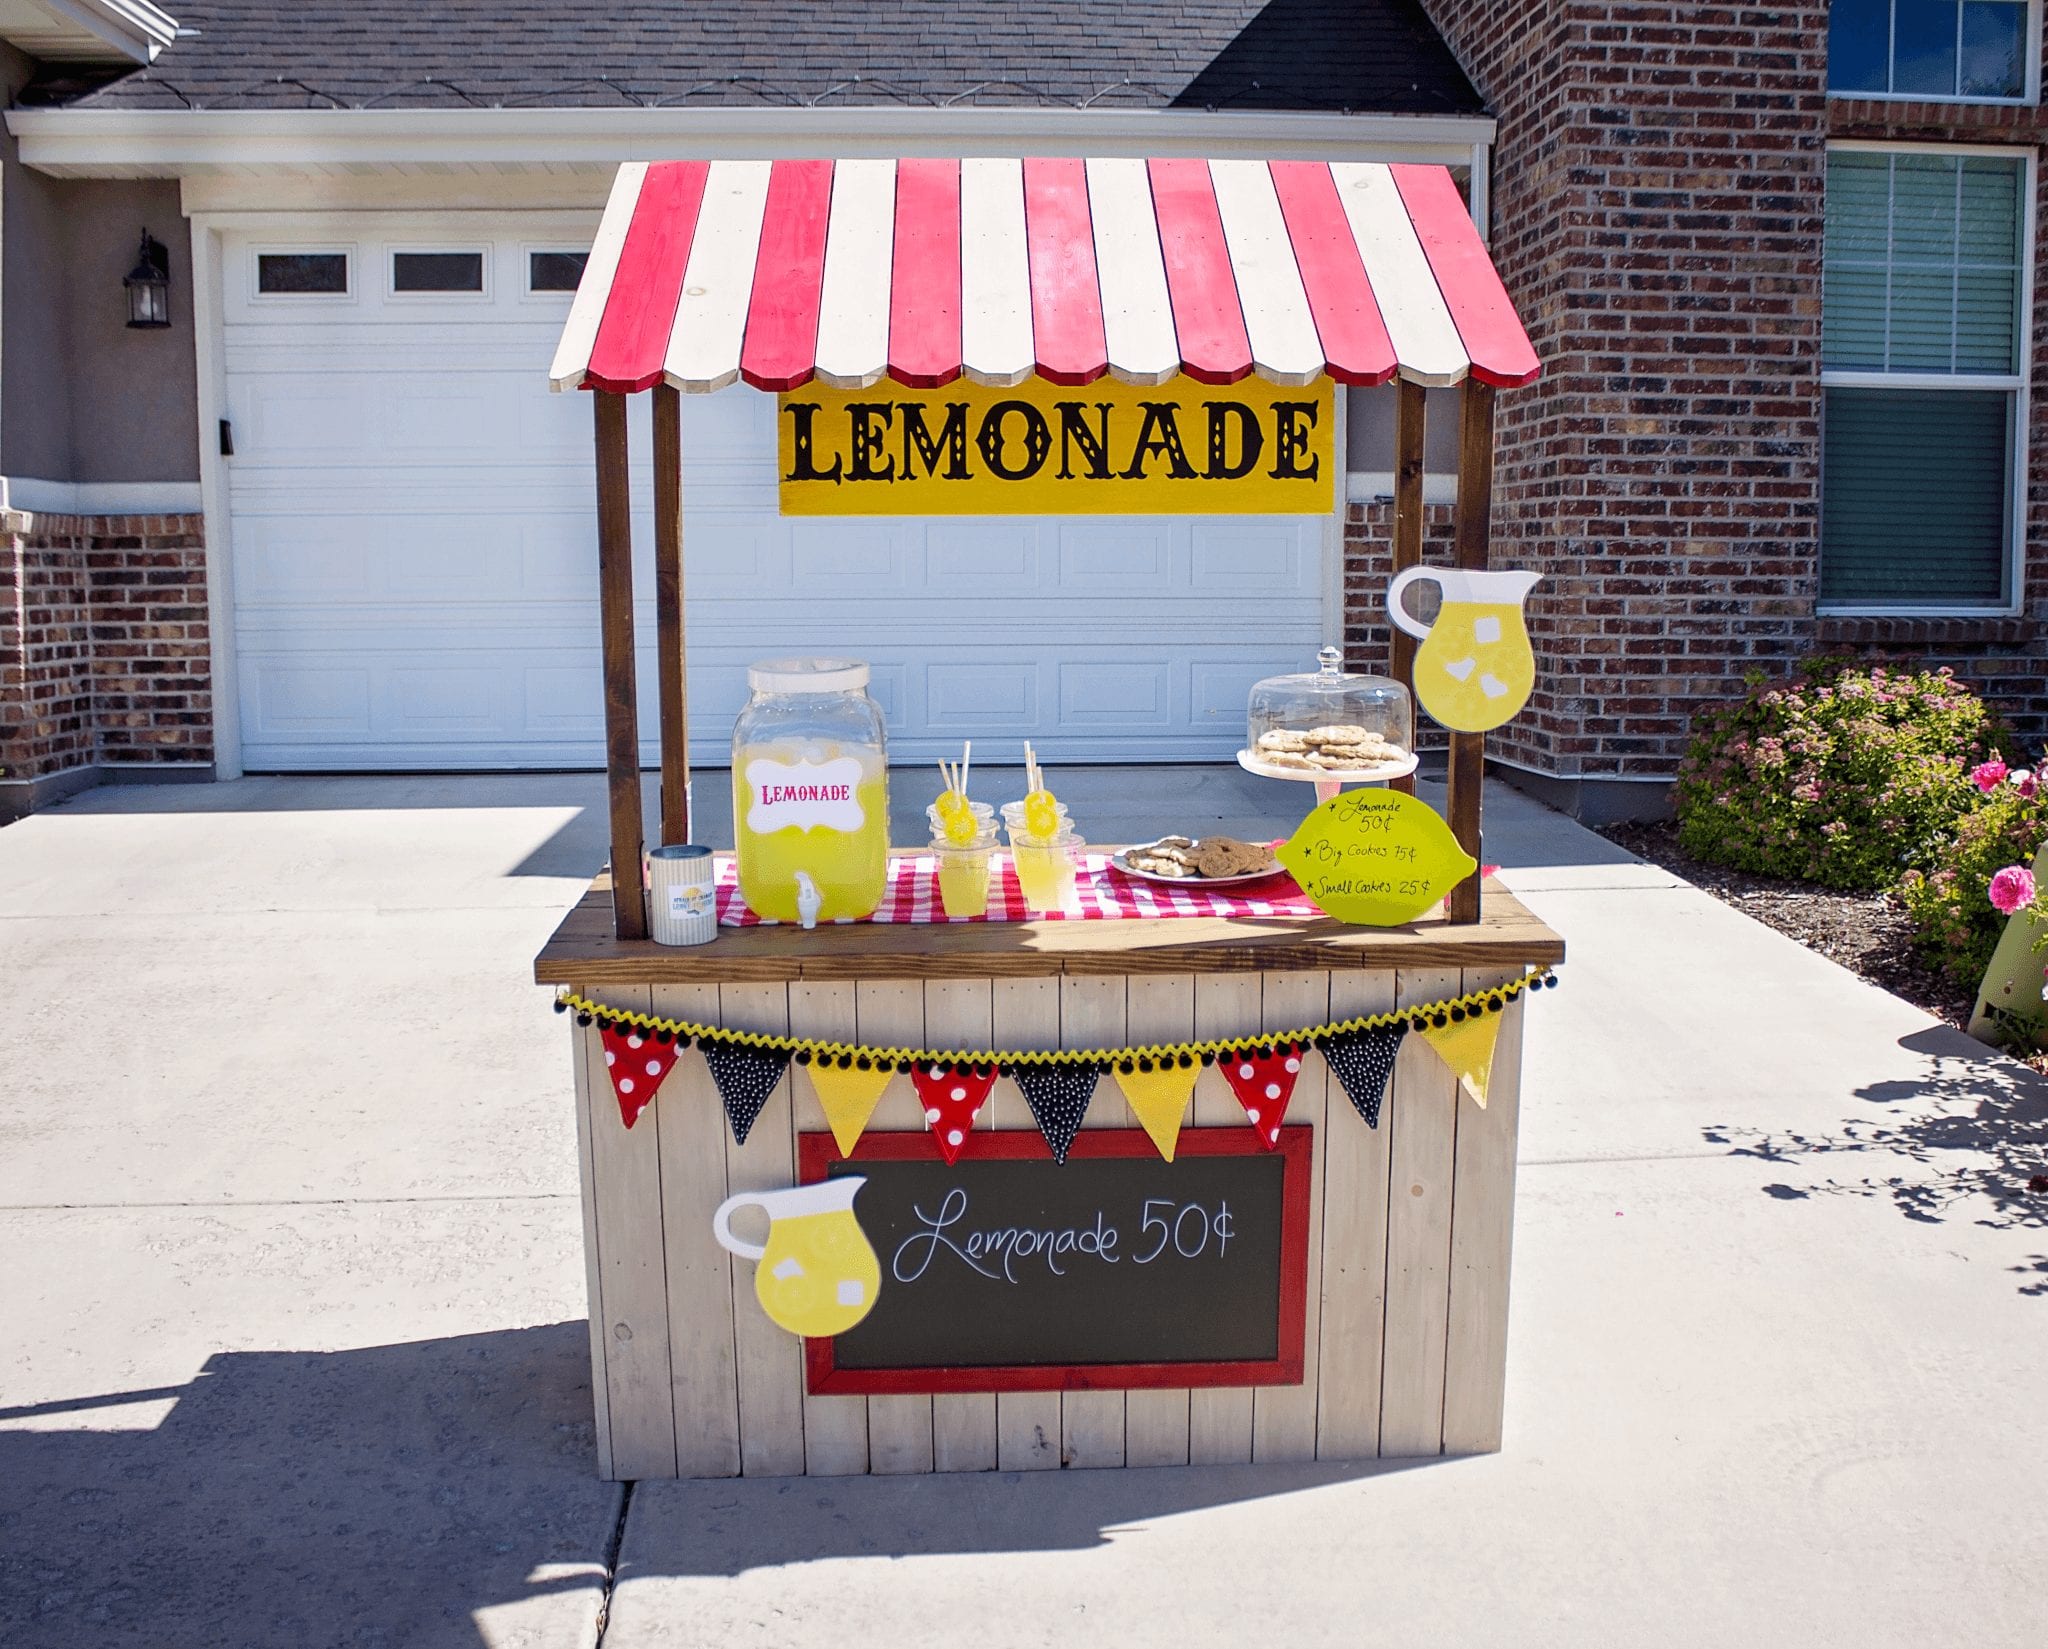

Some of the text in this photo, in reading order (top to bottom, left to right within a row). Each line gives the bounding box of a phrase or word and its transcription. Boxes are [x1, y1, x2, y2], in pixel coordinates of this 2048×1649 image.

[784, 400, 1320, 486] LEMONADE
[1339, 797, 1401, 822] Lemonade
[1359, 814, 1394, 834] 50¢
[1315, 839, 1343, 867] Big
[1347, 843, 1388, 857] Cookies
[1314, 876, 1353, 899] Small
[1355, 880, 1391, 893] Cookies
[893, 1188, 1236, 1284] Lemonade 50¢
